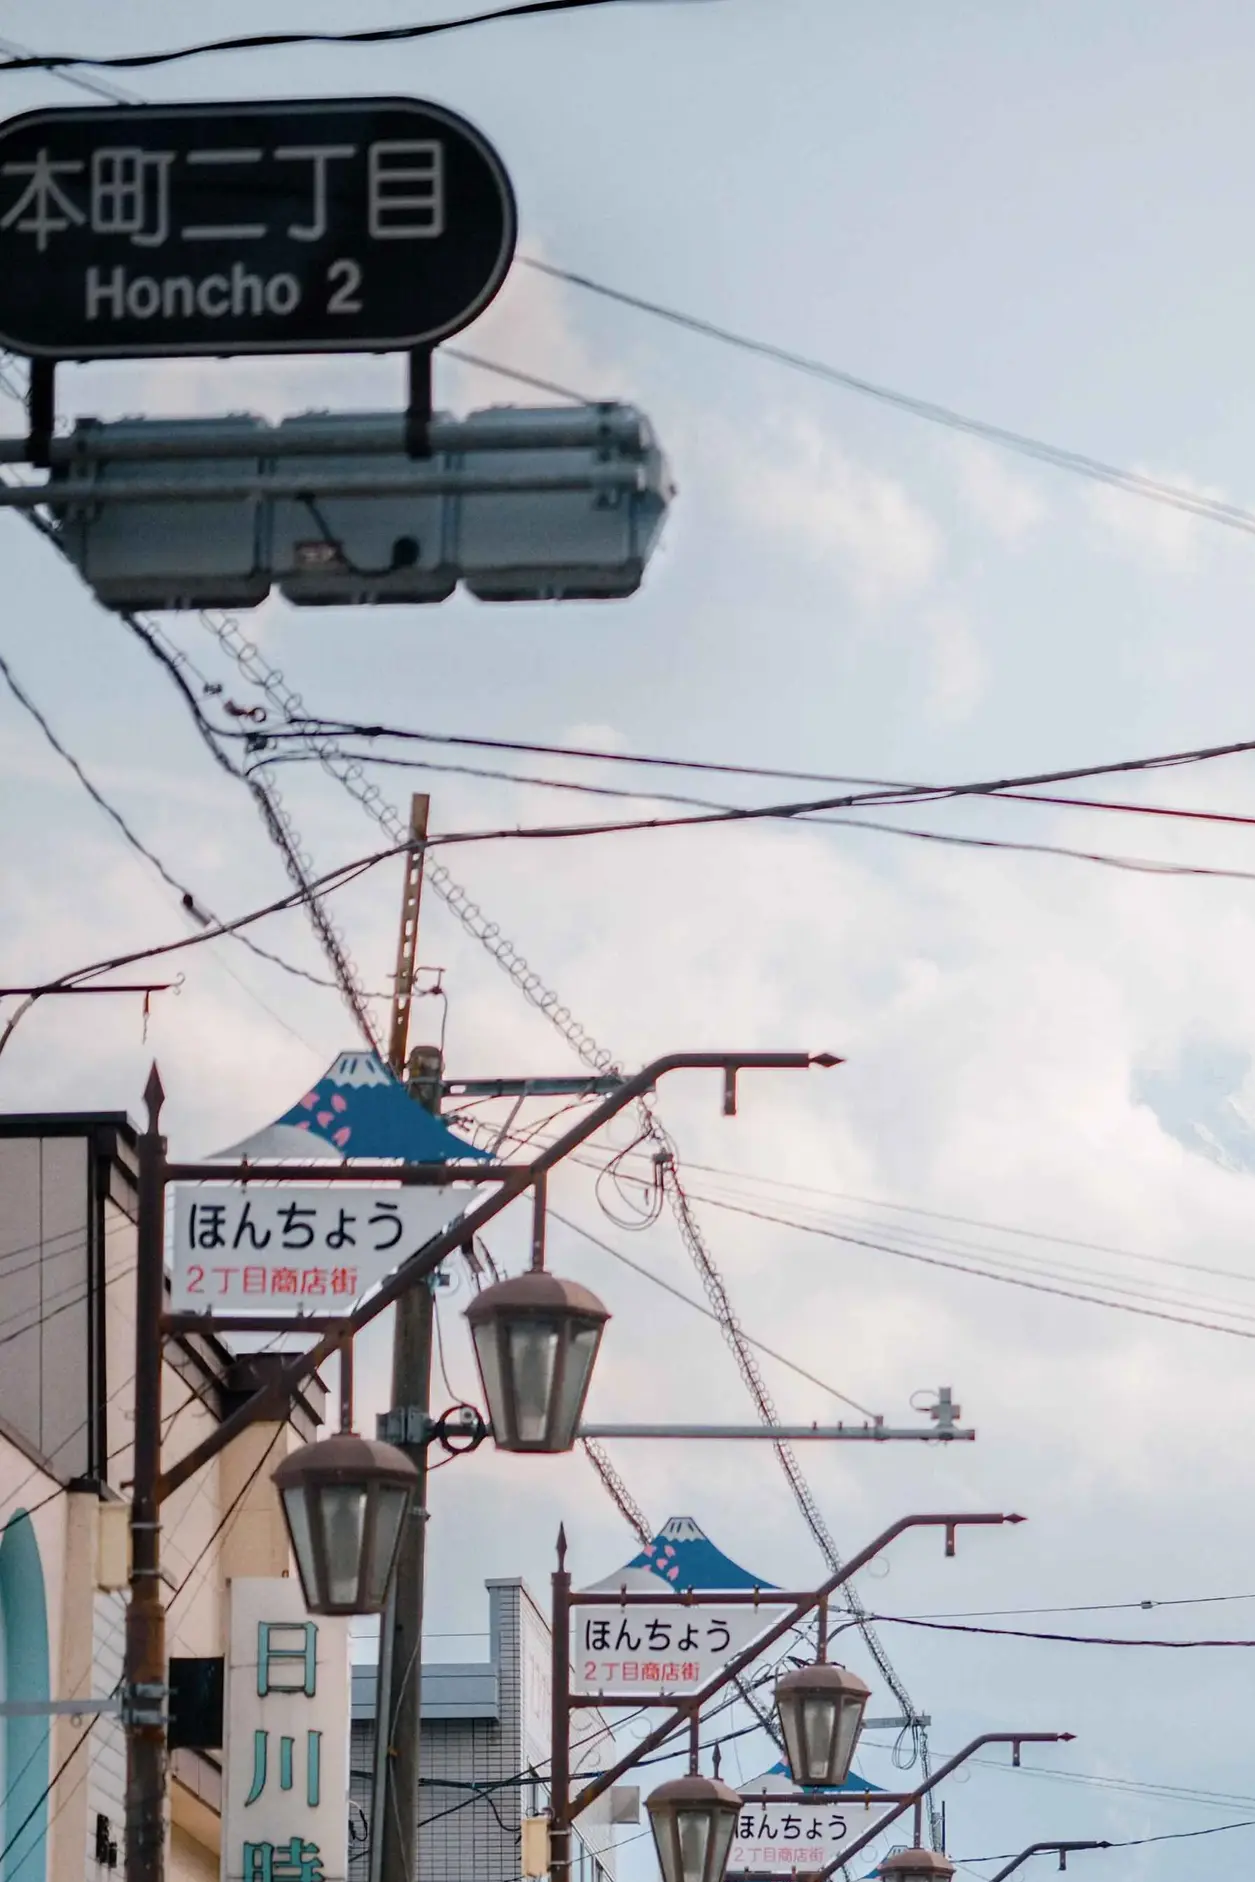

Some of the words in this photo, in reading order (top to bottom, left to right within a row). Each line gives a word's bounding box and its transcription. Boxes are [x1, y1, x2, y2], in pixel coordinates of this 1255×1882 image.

[0, 138, 444, 252] 本町二丁目
[85, 262, 301, 321] Honcho
[326, 260, 364, 314] 2
[187, 1200, 405, 1253] ほんちょう
[186, 1264, 359, 1298] 2丁目商店街
[584, 1616, 733, 1654] ほんちょう
[583, 1660, 701, 1683] 2丁目商店街
[735, 1813, 848, 1841] ほんちょう
[733, 1845, 826, 1863] 2丁目商店街
